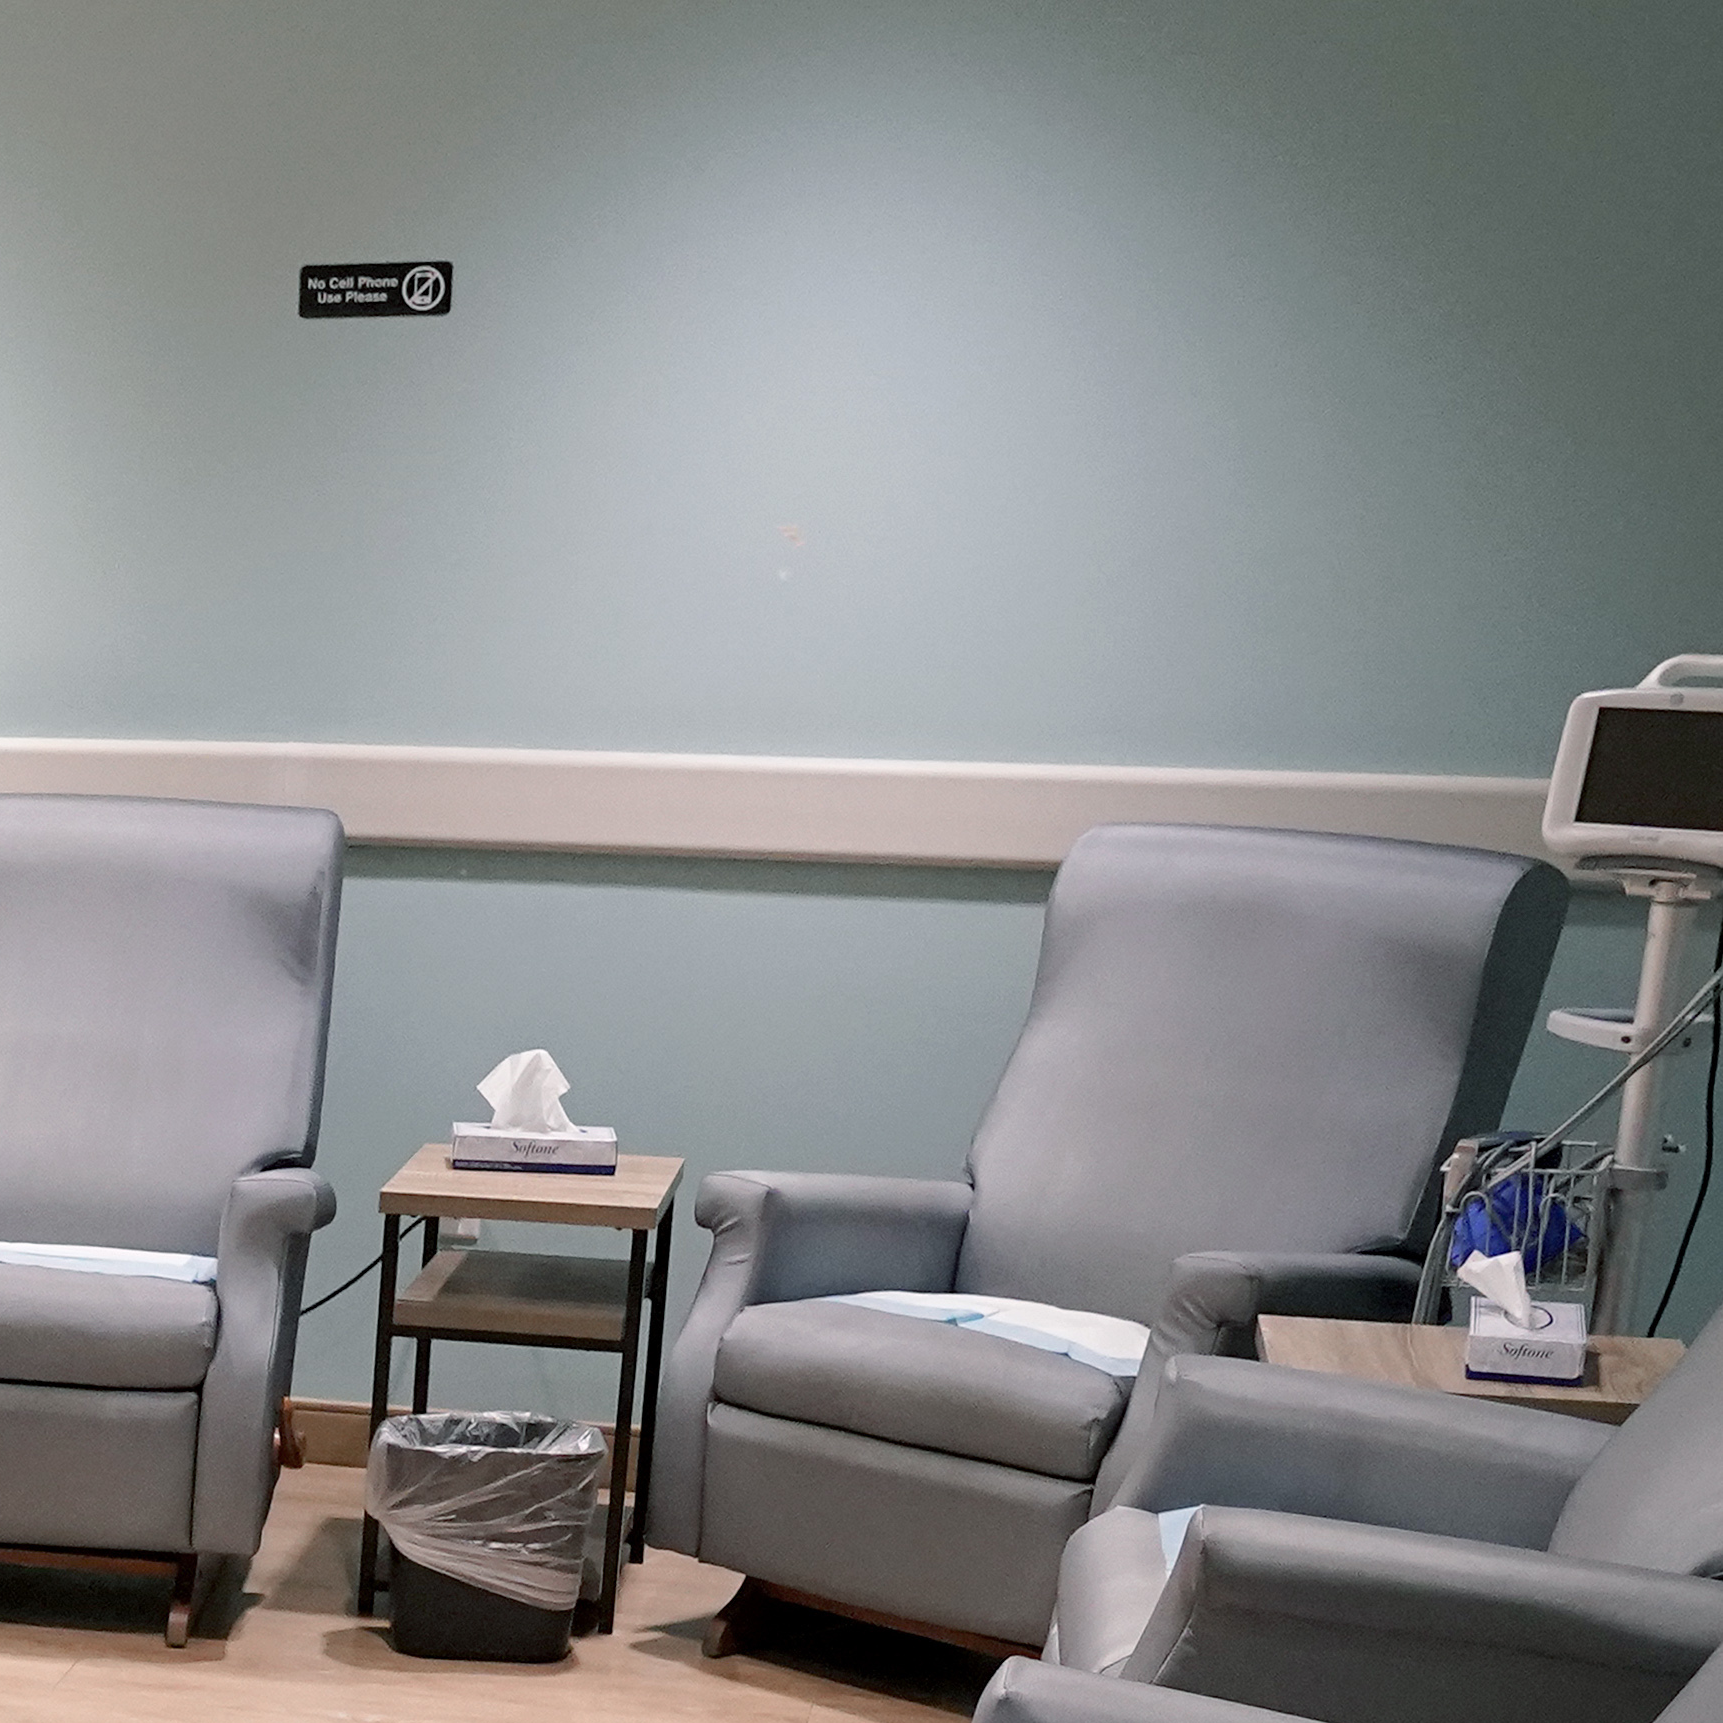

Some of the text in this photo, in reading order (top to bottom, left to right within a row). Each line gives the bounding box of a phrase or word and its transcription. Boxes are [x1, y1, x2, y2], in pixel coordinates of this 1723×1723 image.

[307, 276, 399, 290] No Cell Phone
[317, 291, 388, 304] Use Please
[511, 1140, 560, 1158] Softone
[1498, 1342, 1554, 1360] Softone
